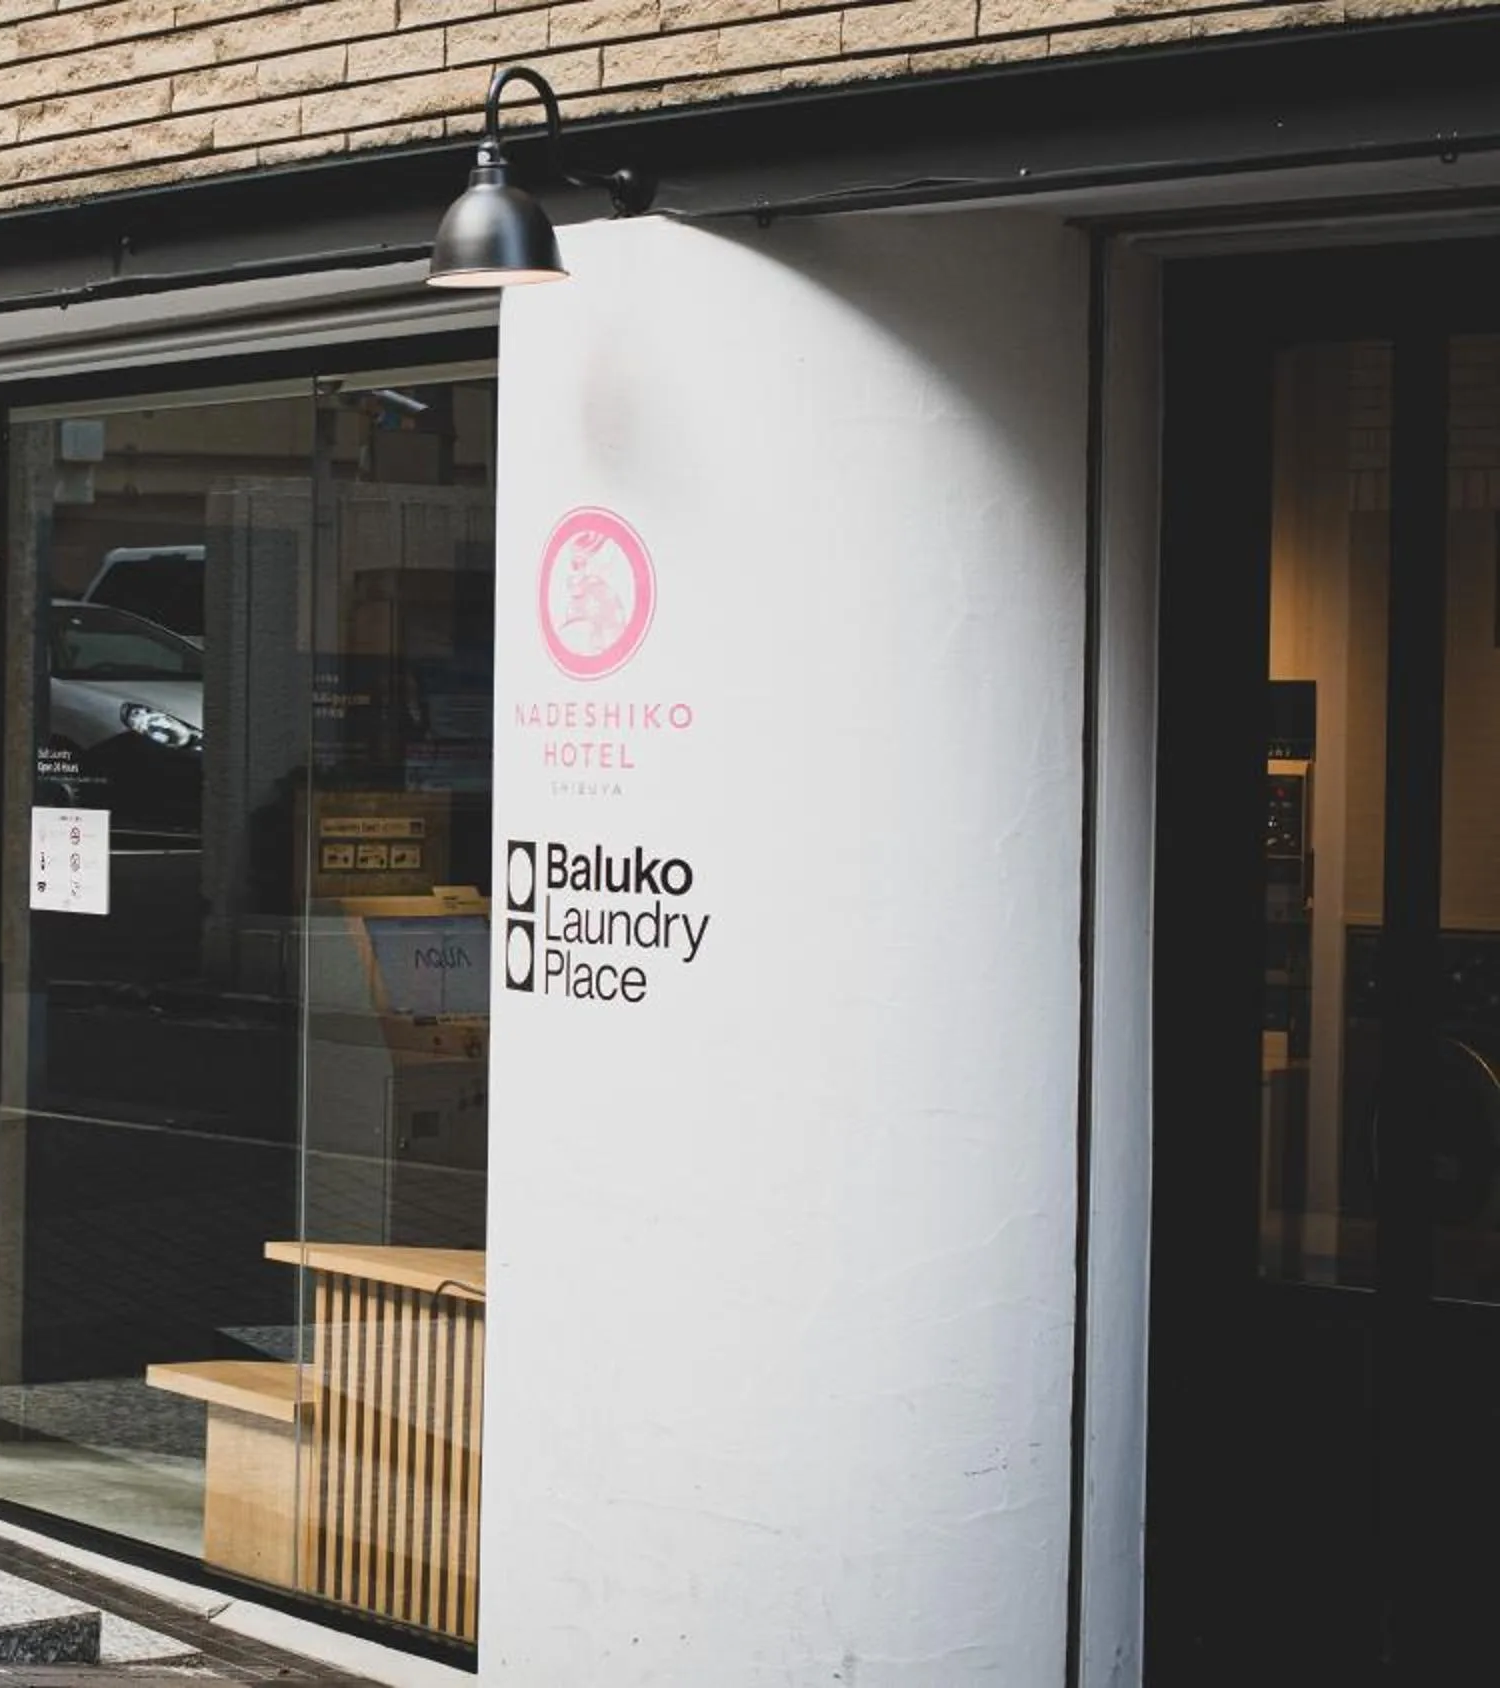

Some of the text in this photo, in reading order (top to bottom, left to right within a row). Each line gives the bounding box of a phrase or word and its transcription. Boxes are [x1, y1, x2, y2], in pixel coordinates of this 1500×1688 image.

[514, 702, 694, 729] NADESHIKO
[544, 742, 636, 768] HOTEL
[545, 842, 694, 896] Baluko
[544, 894, 712, 964] Laundry
[544, 948, 648, 1002] Place
